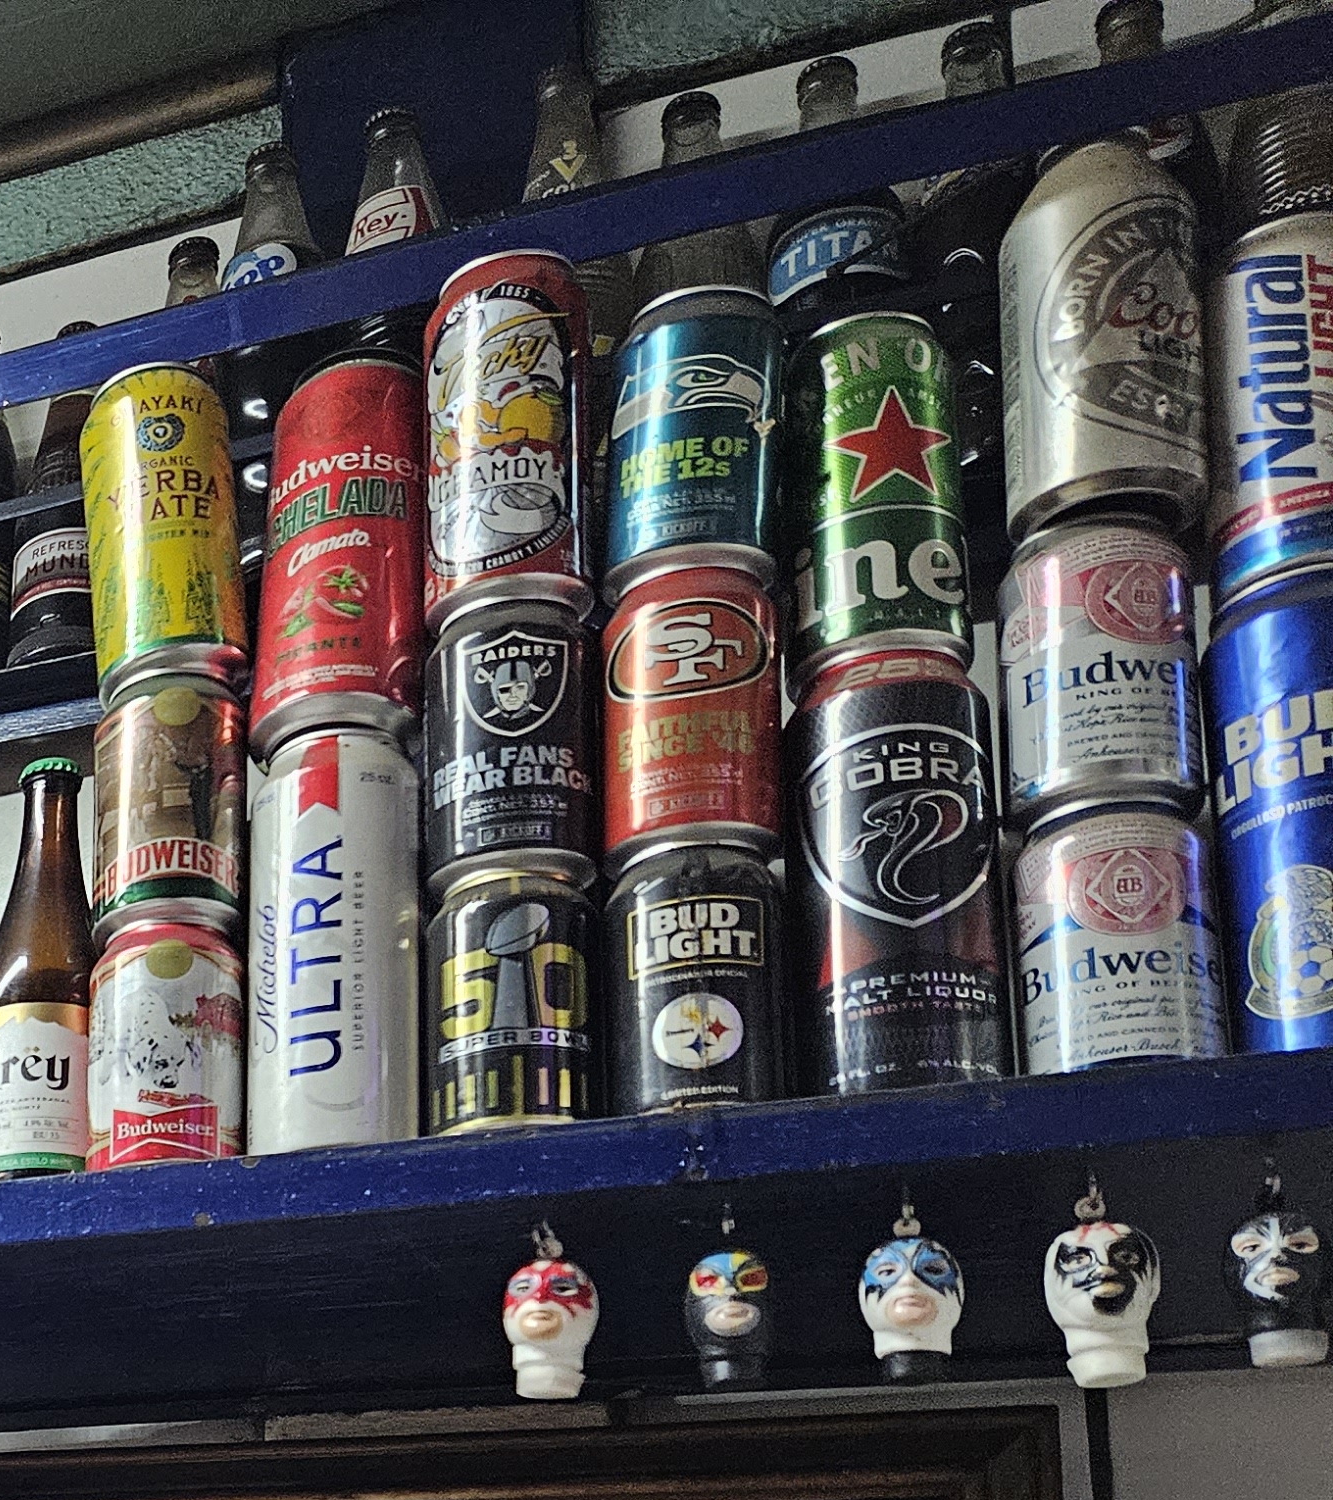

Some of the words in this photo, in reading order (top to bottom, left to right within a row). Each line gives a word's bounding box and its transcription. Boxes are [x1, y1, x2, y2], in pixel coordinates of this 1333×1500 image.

[1237, 253, 1318, 479] Natural
[621, 436, 707, 478] HOME
[710, 434, 750, 457] OF
[469, 644, 557, 670] RAIDERS
[433, 750, 497, 790] REAL
[500, 744, 575, 771] FANS
[852, 740, 952, 763] KING
[506, 761, 592, 793] BLACK
[808, 756, 983, 811] COBRA
[104, 836, 239, 906] BUDWEISER
[350, 869, 366, 912] BEER
[655, 902, 741, 933] BUD
[288, 833, 345, 1077] ULTRA
[350, 916, 366, 968] LIGHT
[635, 928, 760, 968] LIGHT
[251, 900, 278, 1057] Michelob
[907, 984, 999, 1005] LIQUOR
[350, 972, 366, 1052] SUPERIOR
[440, 1030, 520, 1060] SUPER
